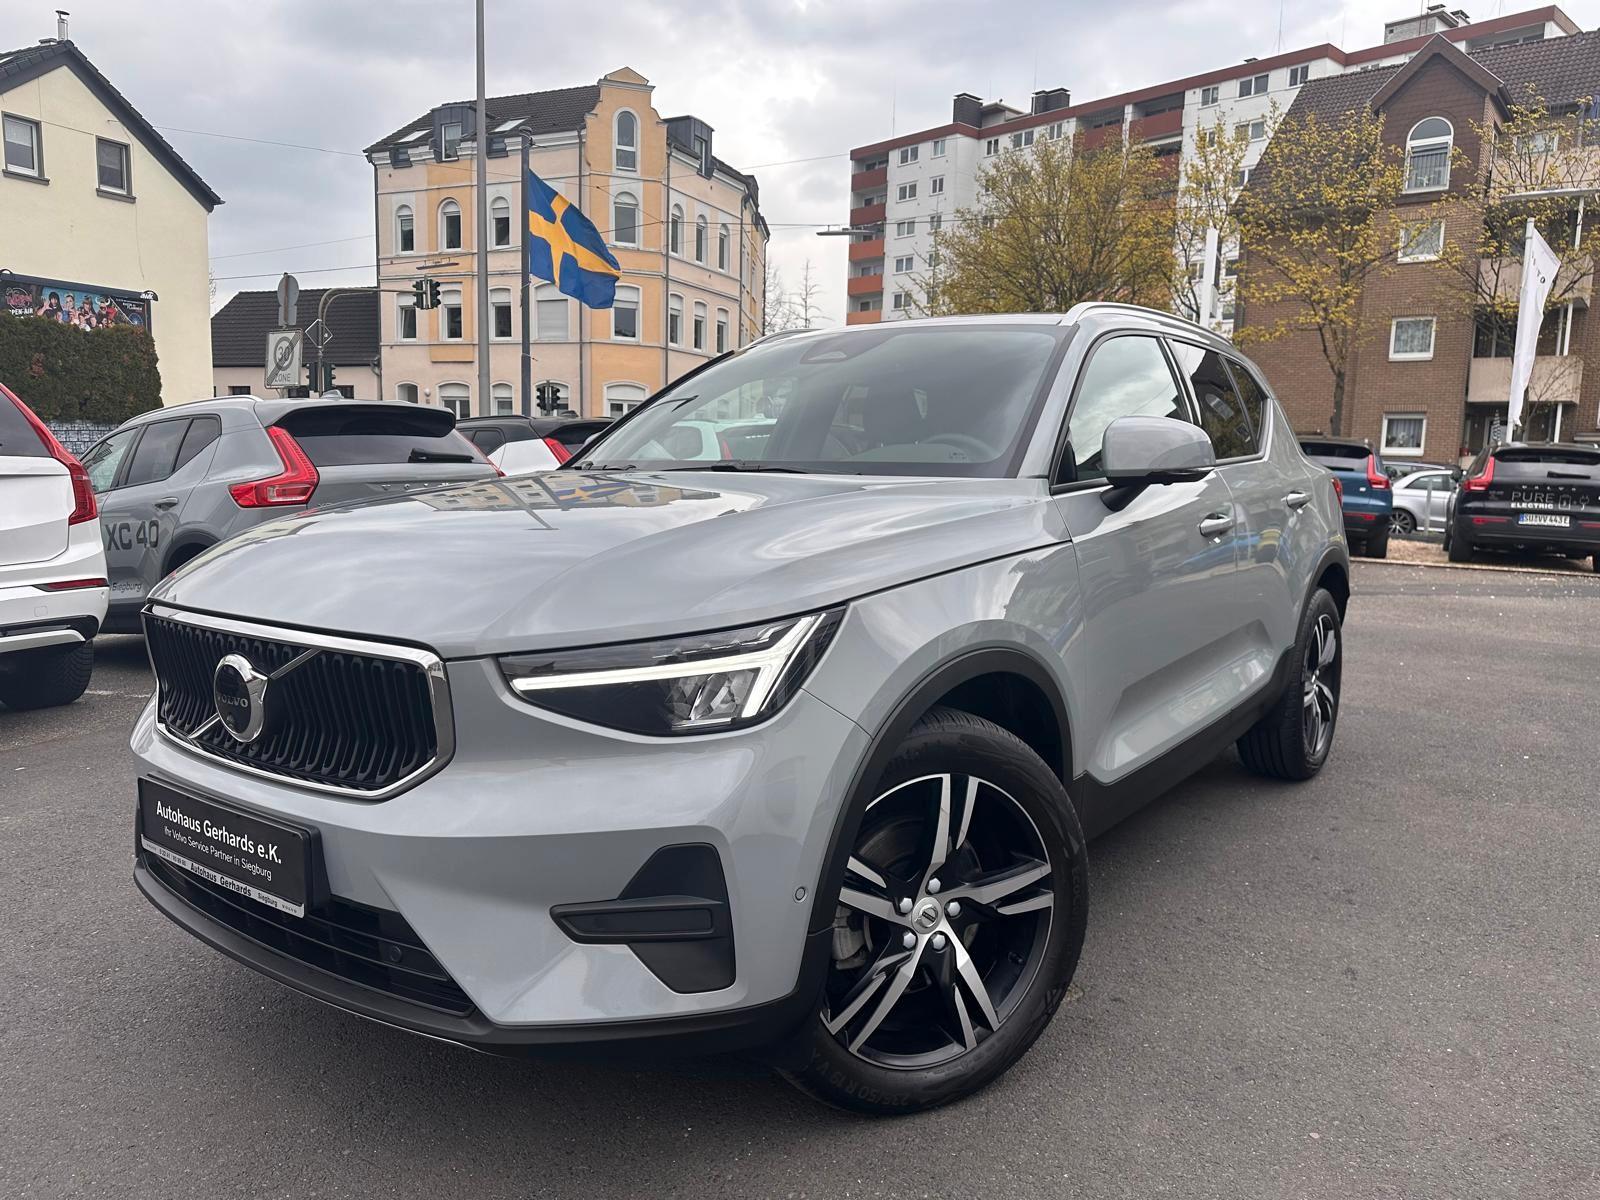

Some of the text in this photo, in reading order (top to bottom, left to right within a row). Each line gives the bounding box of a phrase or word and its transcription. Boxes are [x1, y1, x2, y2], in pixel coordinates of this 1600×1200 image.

[278, 346, 290, 361] 30
[1511, 490, 1554, 503] PURE
[105, 519, 159, 551] XC 40
[112, 581, 142, 593] Siegburg
[156, 800, 282, 864] Autohaus Gerhards e.K.
[164, 826, 272, 882] Ihr Volvo Service Partner in Siegburg
[190, 862, 217, 882] Autohaus
[219, 876, 252, 897] Gerhards
[257, 892, 278, 908] Siegburg
